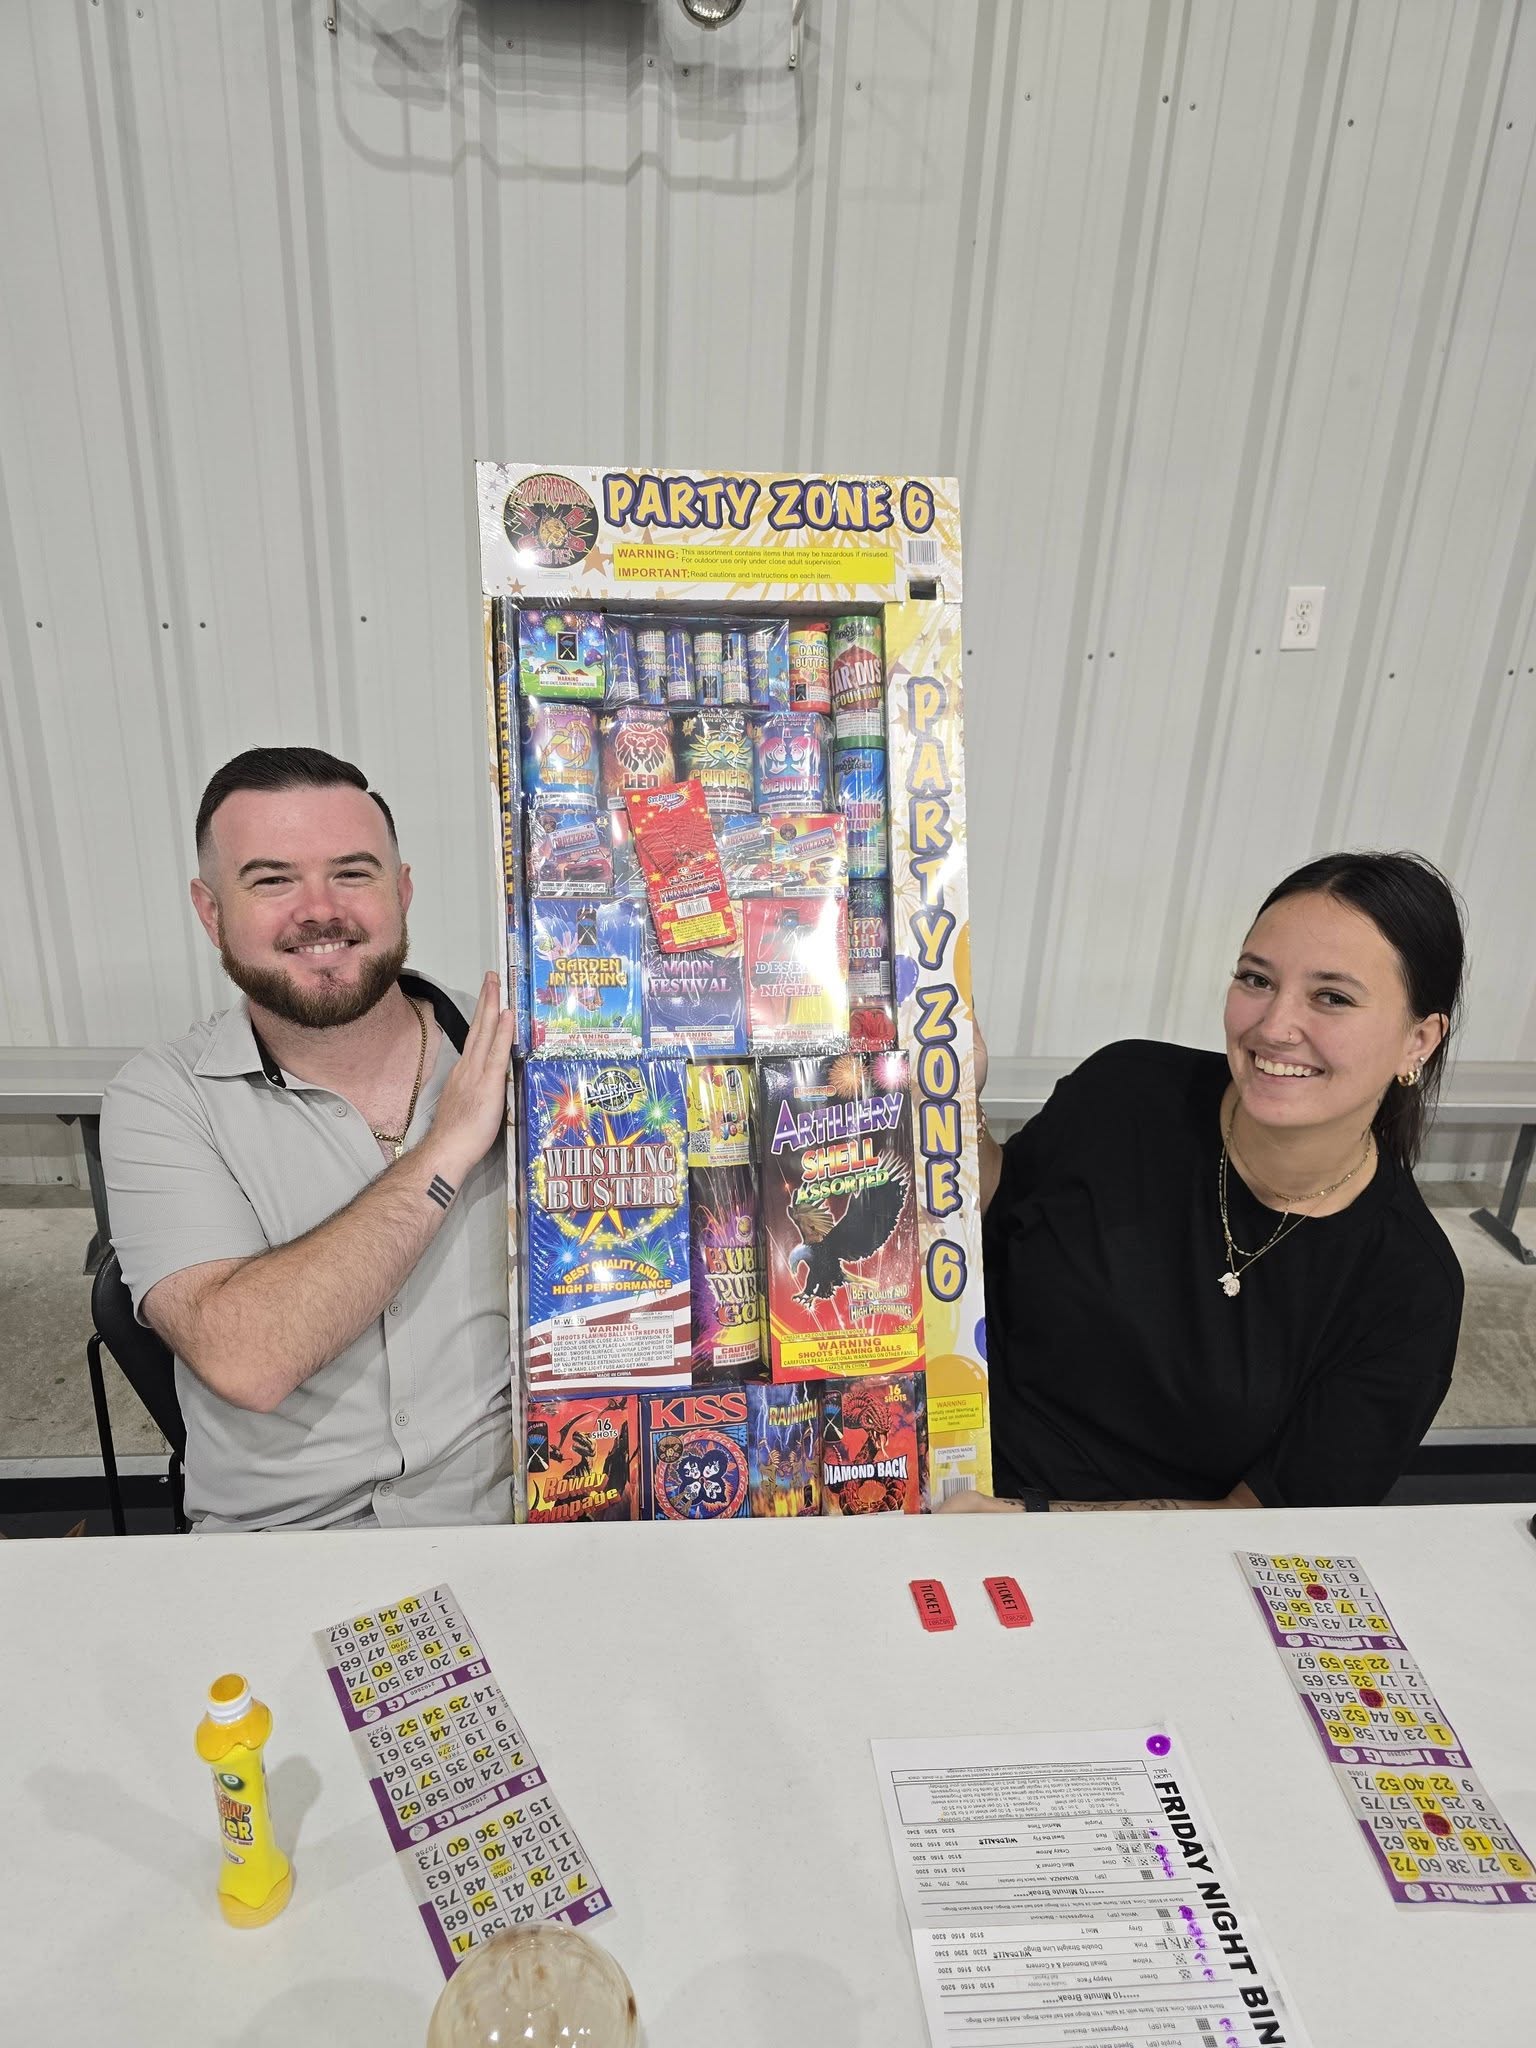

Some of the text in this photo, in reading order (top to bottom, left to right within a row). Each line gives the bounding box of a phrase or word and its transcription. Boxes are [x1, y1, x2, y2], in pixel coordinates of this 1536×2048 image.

[602, 473, 761, 531] PARTY
[767, 479, 894, 532] ZONE
[901, 481, 935, 533] 6
[618, 549, 679, 559] WARNING:
[618, 568, 690, 578] IMPORTANT:
[623, 773, 659, 790] LEO
[846, 803, 881, 819] STRONG
[555, 957, 622, 973] GARDEN
[662, 959, 714, 976] MOON
[548, 972, 628, 987] IN SPRING
[650, 977, 731, 992] FESTIVAL
[777, 974, 803, 984] AT
[761, 985, 822, 997] NIGHT
[907, 674, 967, 1304] PARTY ZONE 6
[584, 1081, 641, 1099] MIRACLE
[771, 1092, 903, 1155] ARTILLERY
[544, 1145, 675, 1177] WHISTLING
[801, 1138, 880, 1182] SHELL
[546, 1175, 677, 1211] BUSTER
[796, 1168, 889, 1205] ASSORTED
[563, 1259, 660, 1284] BEST QUALITY AND
[552, 1279, 672, 1295] HIGH PERFORMANCE
[851, 1284, 908, 1300] BEST QUALITY AND
[850, 1303, 912, 1320] HIGH PERFORMANCE
[588, 1324, 639, 1333] WARNING
[818, 1338, 881, 1350] WARNING
[798, 1350, 834, 1359] SHOOTS
[835, 1348, 873, 1356] FLAMING
[889, 1384, 901, 1395] 16
[884, 1394, 907, 1403] SHOTS
[937, 1400, 967, 1408] WARNING
[650, 1393, 748, 1429] KISS
[597, 1419, 612, 1430] 16
[592, 1430, 619, 1439] SHOTS
[824, 1456, 907, 1485] DIAMOND BACK
[543, 1471, 609, 1500] Rowdy
[529, 1488, 619, 1523] Rampage
[920, 1584, 941, 1615] TICKET
[994, 1581, 1018, 1611] TICKET
[1319, 1708, 1436, 1723] 5 16 44 52 69
[1328, 1725, 1445, 1741] 1 23 41 58 66
[384, 1719, 507, 1784] 9 19 55 64
[391, 1733, 519, 1801] 15 29 35 57 70
[399, 1752, 523, 1820] 2 24 40 58 62
[1154, 1781, 1286, 2048] FRIDAY NIGHT BIN
[1057, 1944, 1080, 1952] Straight
[1093, 1975, 1112, 1983] Happy
[1084, 1992, 1111, 2001] Minute
